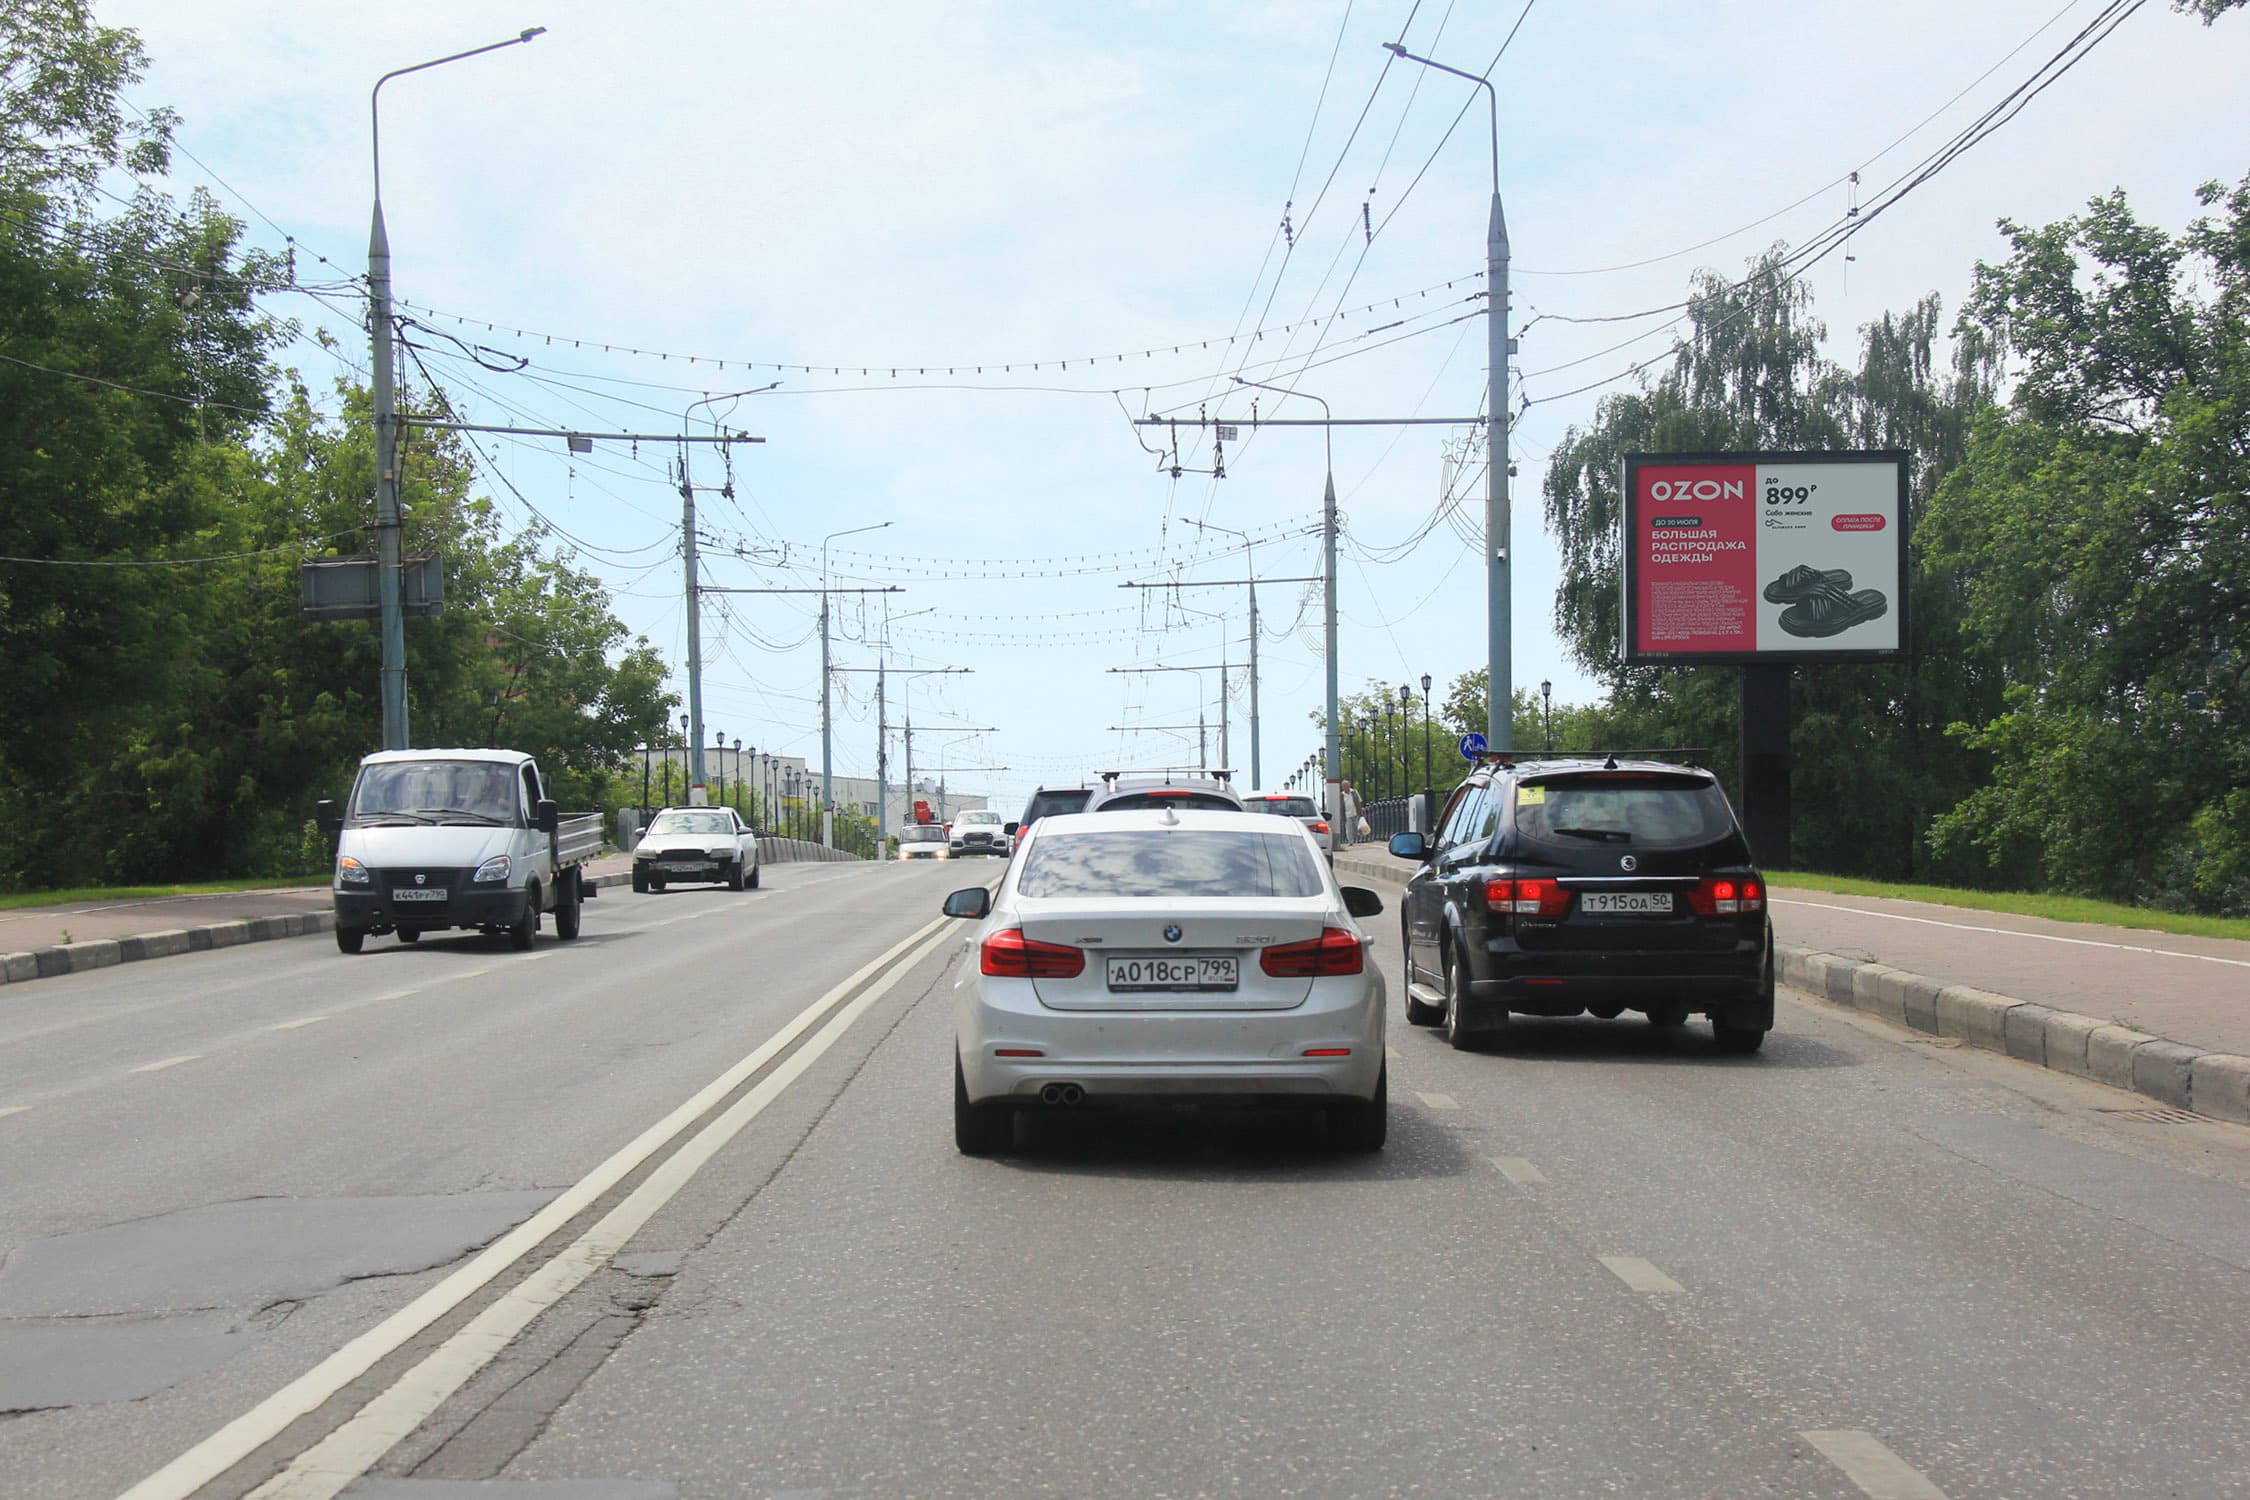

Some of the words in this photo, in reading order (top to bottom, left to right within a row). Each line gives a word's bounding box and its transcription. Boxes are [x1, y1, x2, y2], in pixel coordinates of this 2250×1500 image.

[1650, 479, 1744, 502] OZON
[1655, 518, 1666, 527] ДО
[1651, 529, 1718, 540] БОЛЬШАЯ
[1651, 541, 1746, 552] РАСПРОДАЖА
[1651, 553, 1713, 564] ОДЕЖДЫ
[1200, 960, 1231, 976] 799
